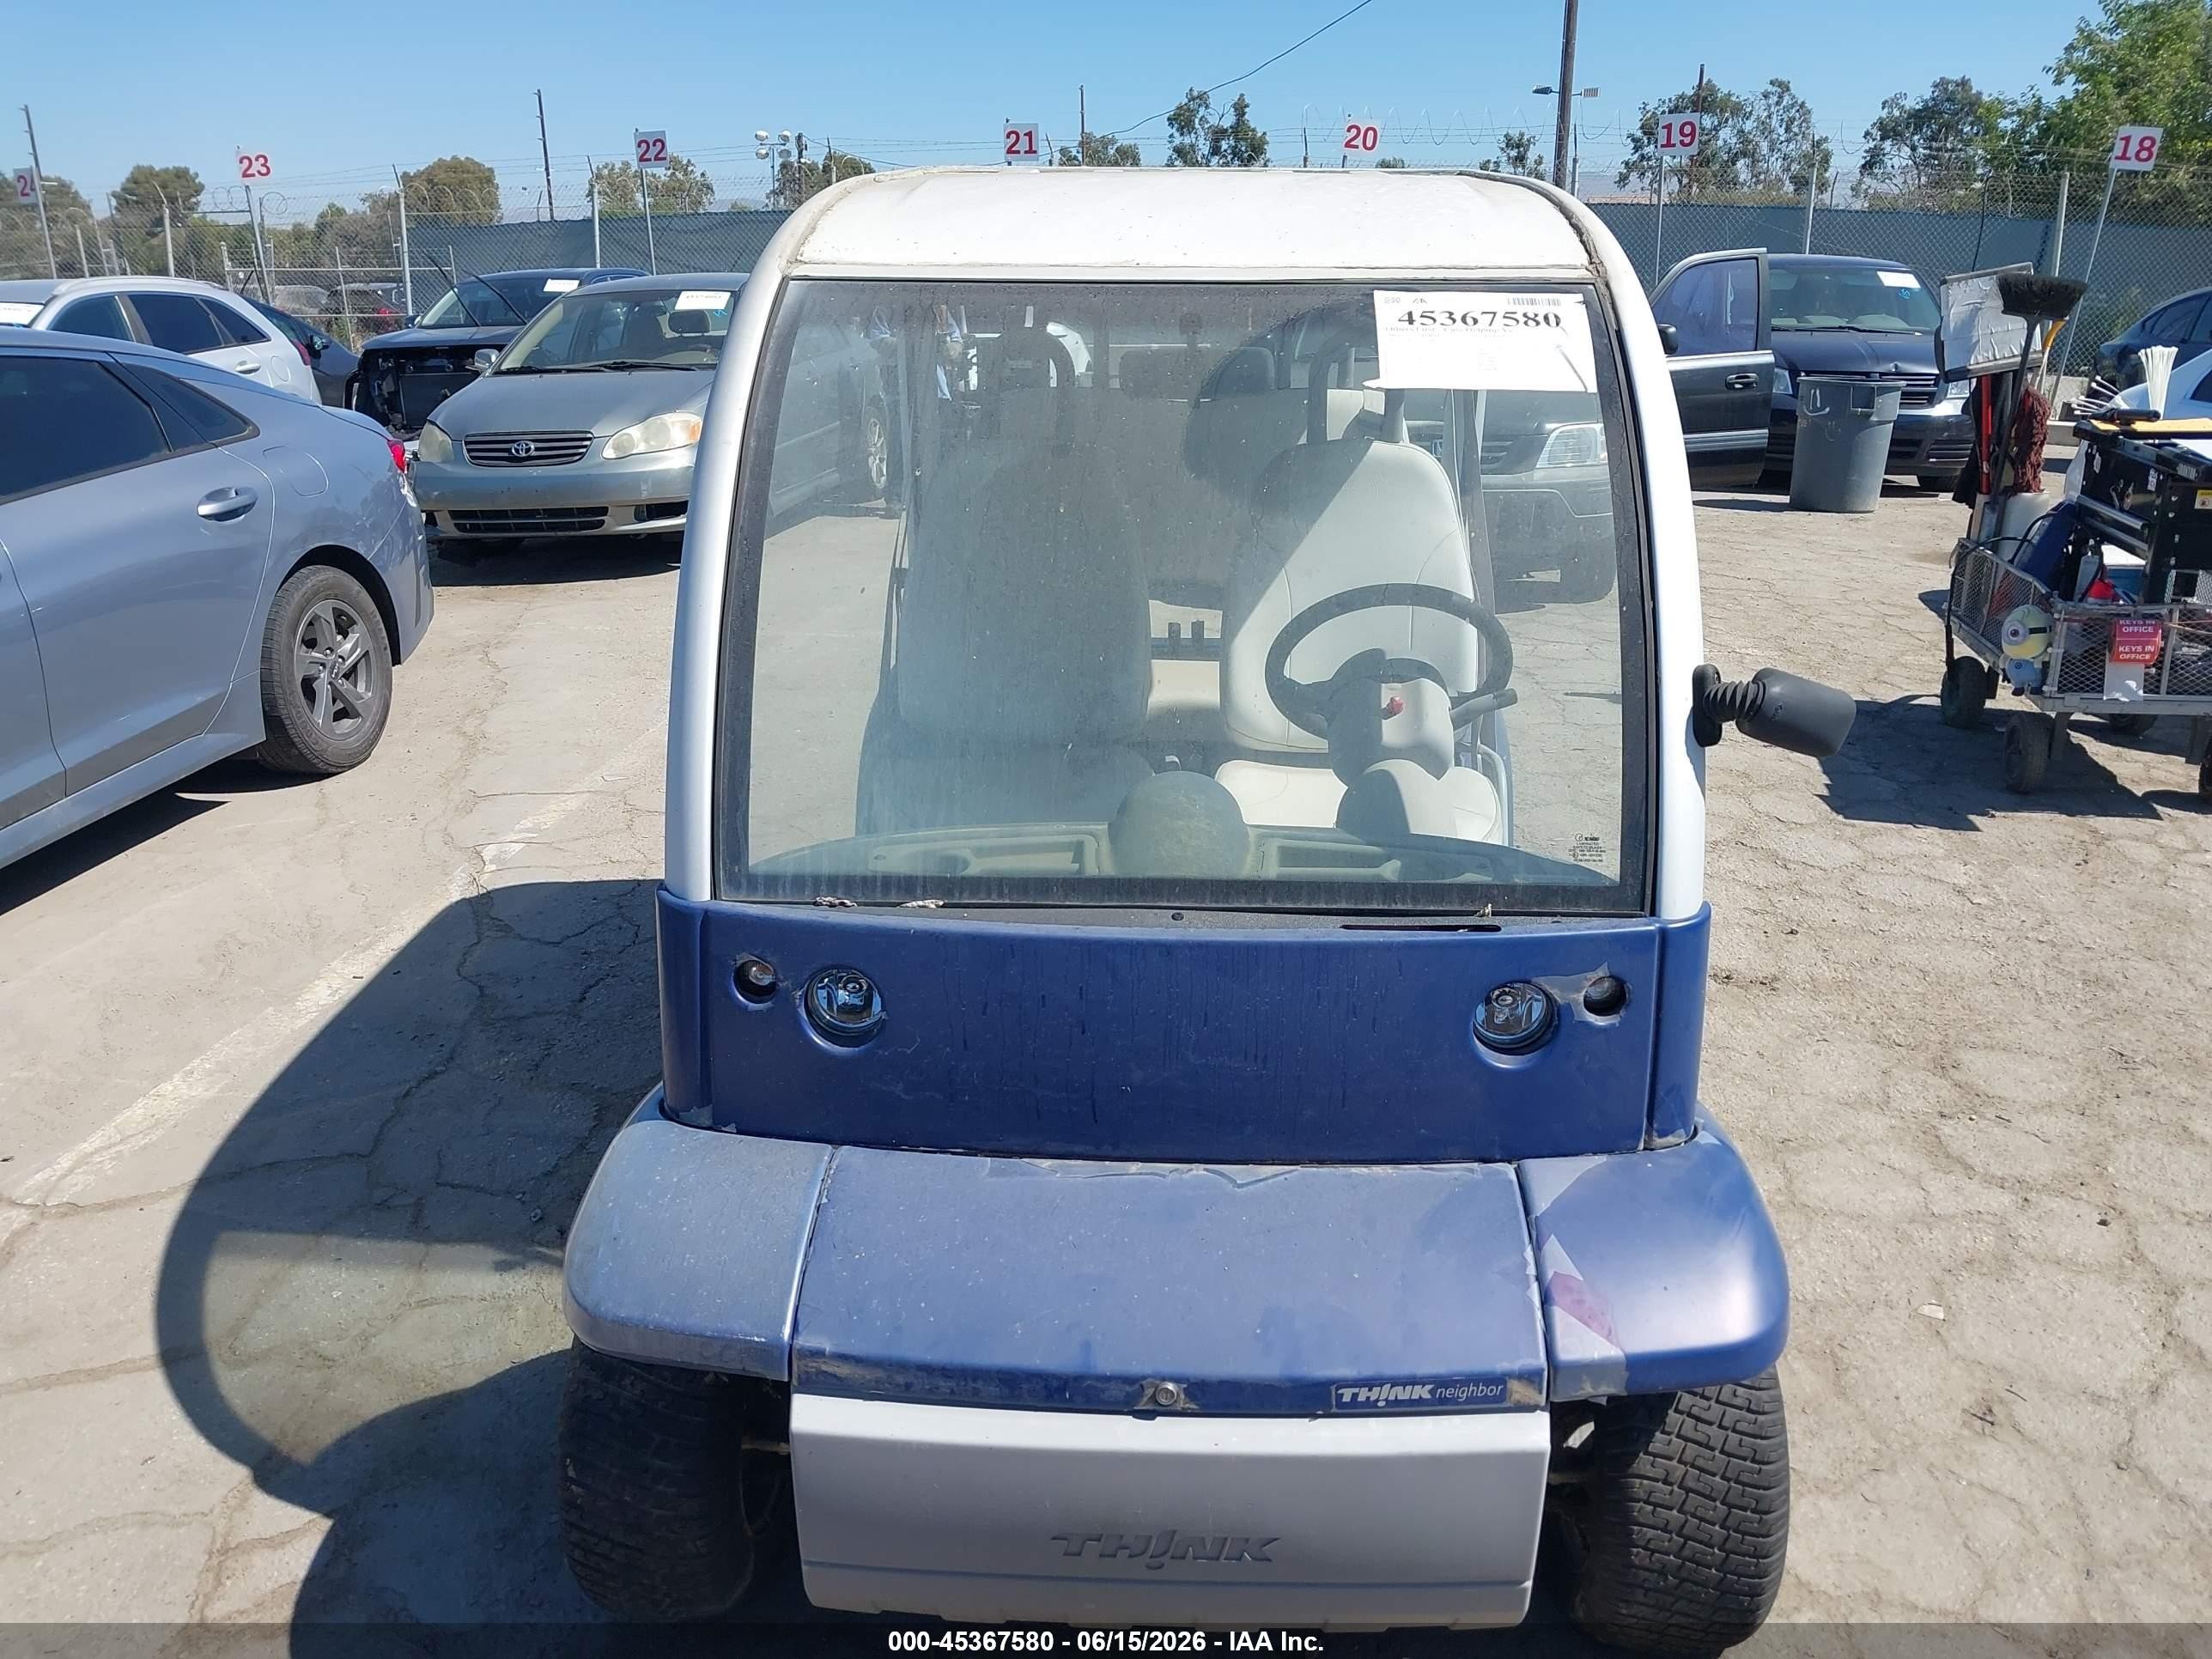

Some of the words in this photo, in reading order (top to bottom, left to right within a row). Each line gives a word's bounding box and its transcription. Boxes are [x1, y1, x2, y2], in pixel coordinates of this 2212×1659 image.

[1005, 130, 1037, 155] 21
[1344, 124, 1378, 151] 20
[1660, 120, 1698, 149] 19
[637, 138, 667, 162] 22
[2114, 135, 2157, 163] 18
[240, 154, 271, 179] 23
[1398, 310, 1562, 327] 45367580
[1436, 1382, 1504, 1401] neighbor
